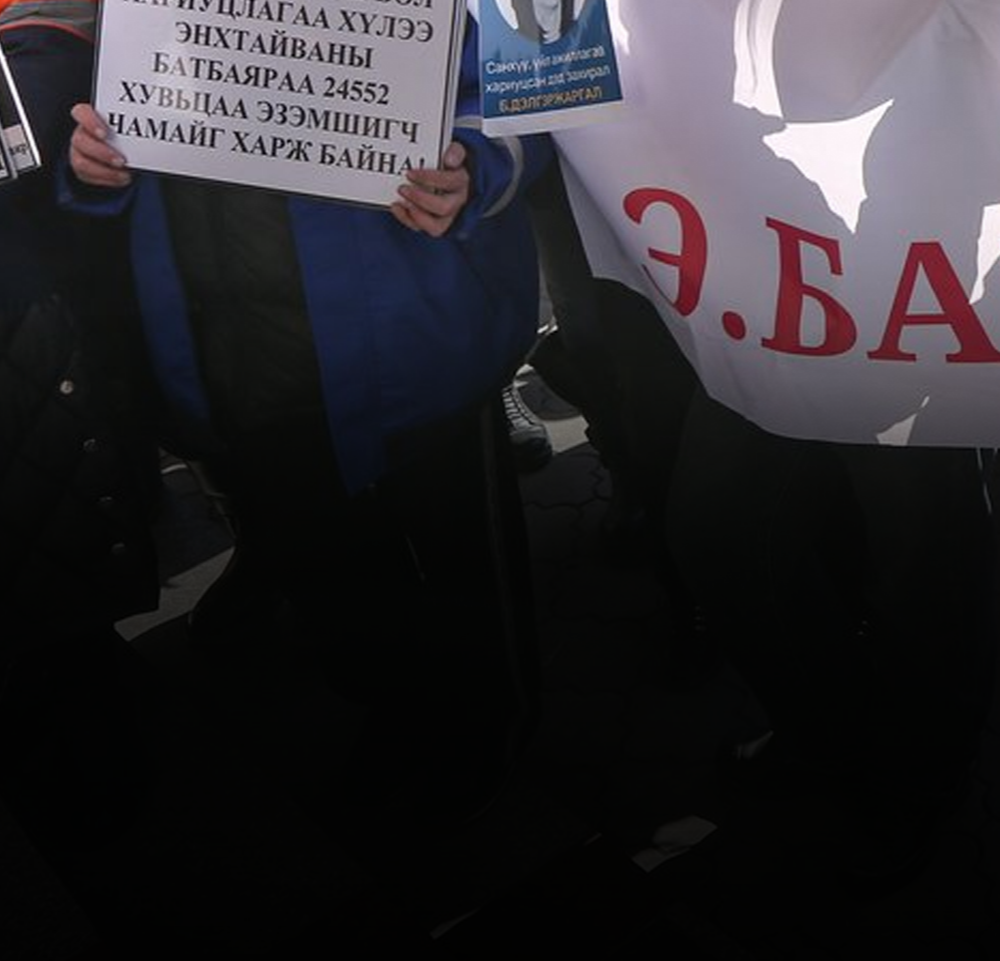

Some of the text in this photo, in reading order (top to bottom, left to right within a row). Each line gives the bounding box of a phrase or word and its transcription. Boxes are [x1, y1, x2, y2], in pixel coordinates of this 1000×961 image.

[175, 21, 373, 70] ЭНХТАЙВАНЫ
[338, 10, 434, 43] ХҮЛЭЭ
[152, 52, 390, 106] БАТБАЯРАА 24552
[107, 112, 225, 149] ЧАМАЙГ
[231, 131, 313, 163] ХАРЖ
[119, 81, 419, 144] ХУВЬЦАА ЭЗЭМШИГЧ
